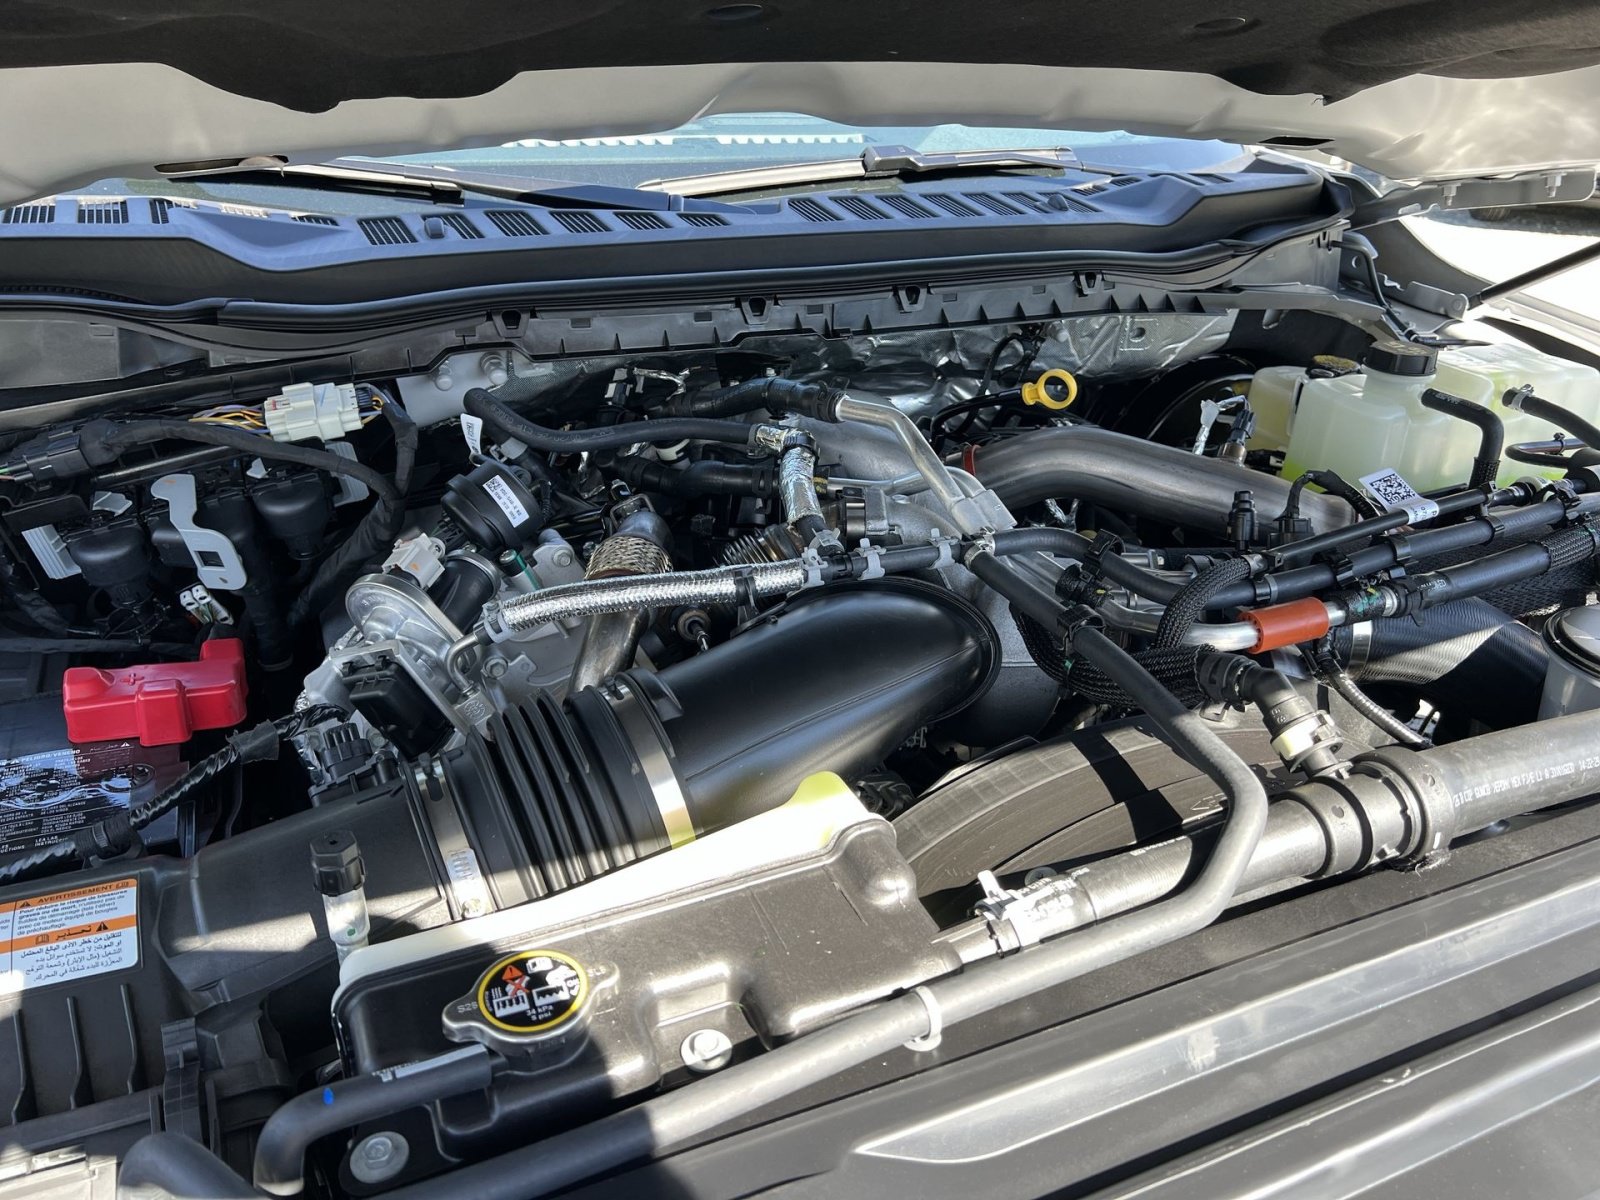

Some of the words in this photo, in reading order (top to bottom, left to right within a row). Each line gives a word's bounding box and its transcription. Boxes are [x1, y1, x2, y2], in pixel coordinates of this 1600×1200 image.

[38, 884, 113, 903] AVERTISSEMENT
[18, 911, 41, 920] graves
[42, 917, 64, 925] moteur
[538, 1004, 554, 1013] kPa
